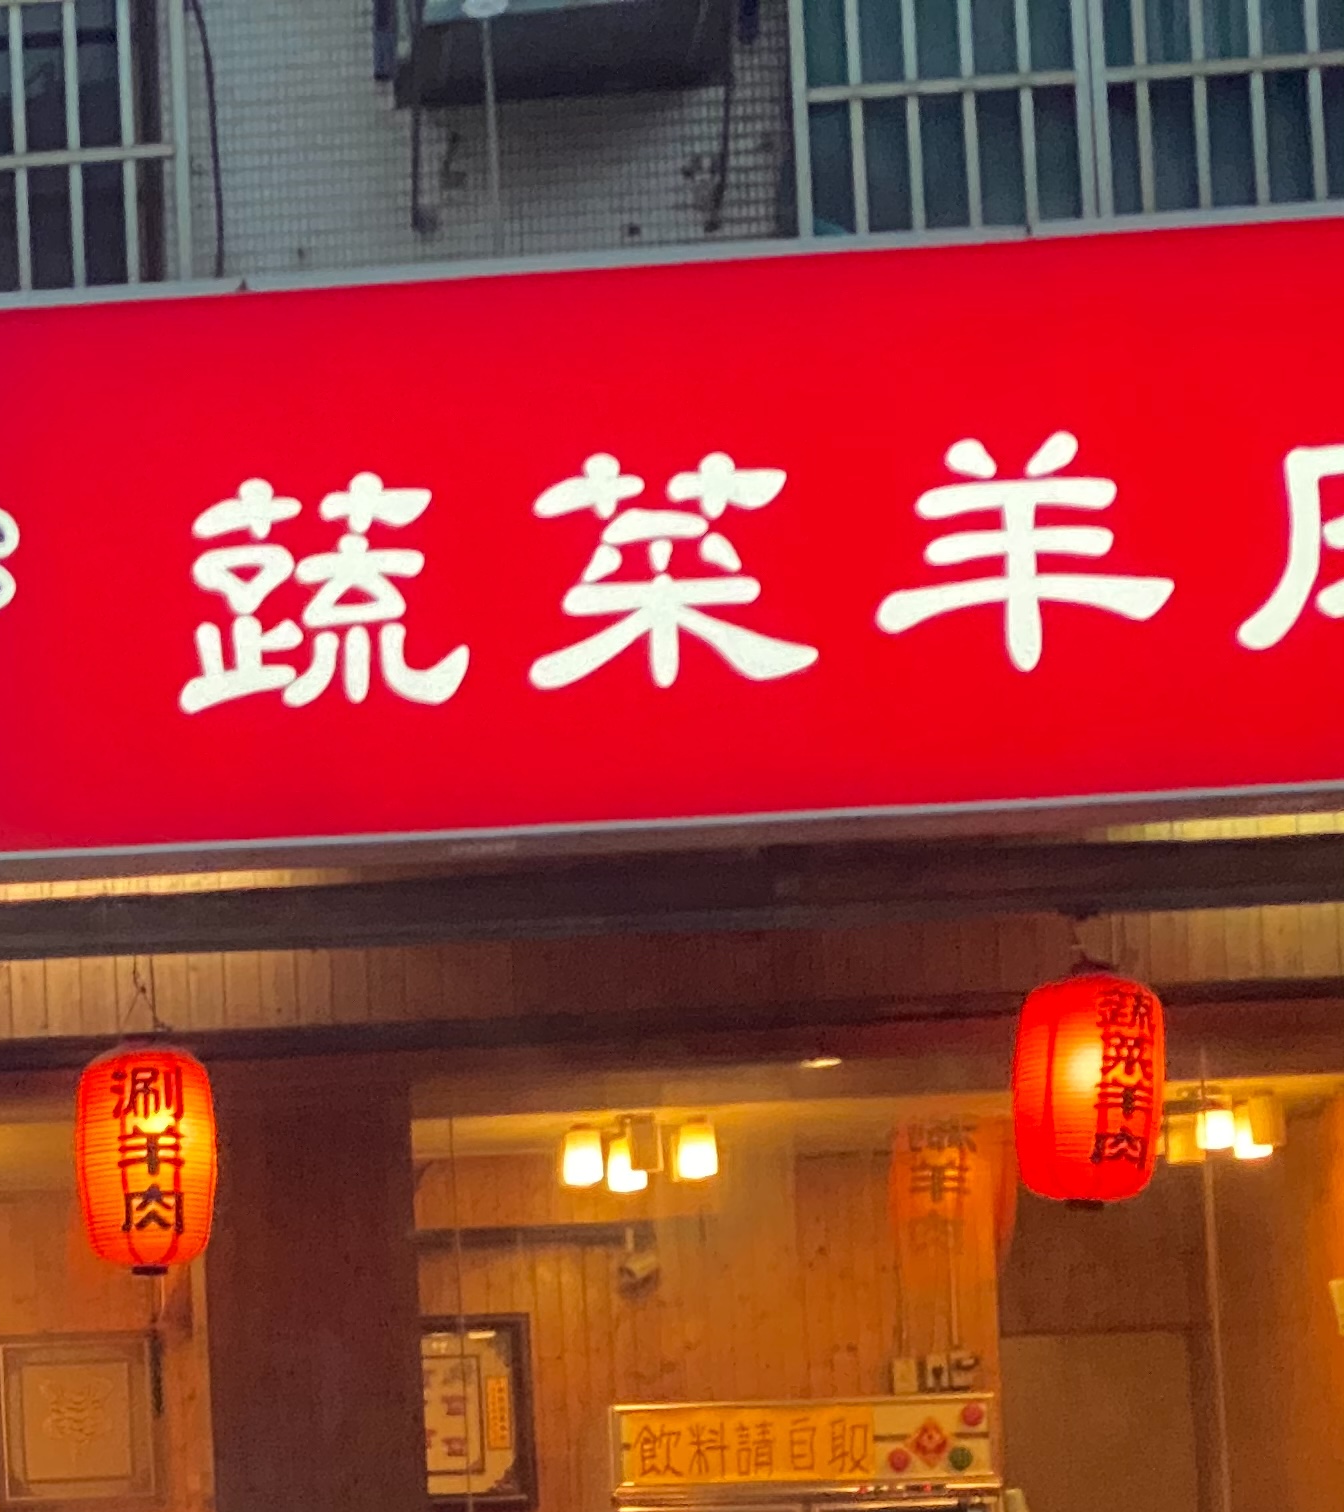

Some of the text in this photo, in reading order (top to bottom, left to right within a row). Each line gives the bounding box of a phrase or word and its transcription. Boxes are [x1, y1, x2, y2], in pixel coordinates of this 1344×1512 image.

[109, 1066, 185, 1235] 涮羊肉
[1088, 983, 1155, 1170] 蔬菜羊肉
[633, 1417, 871, 1478] 飲料請自取
